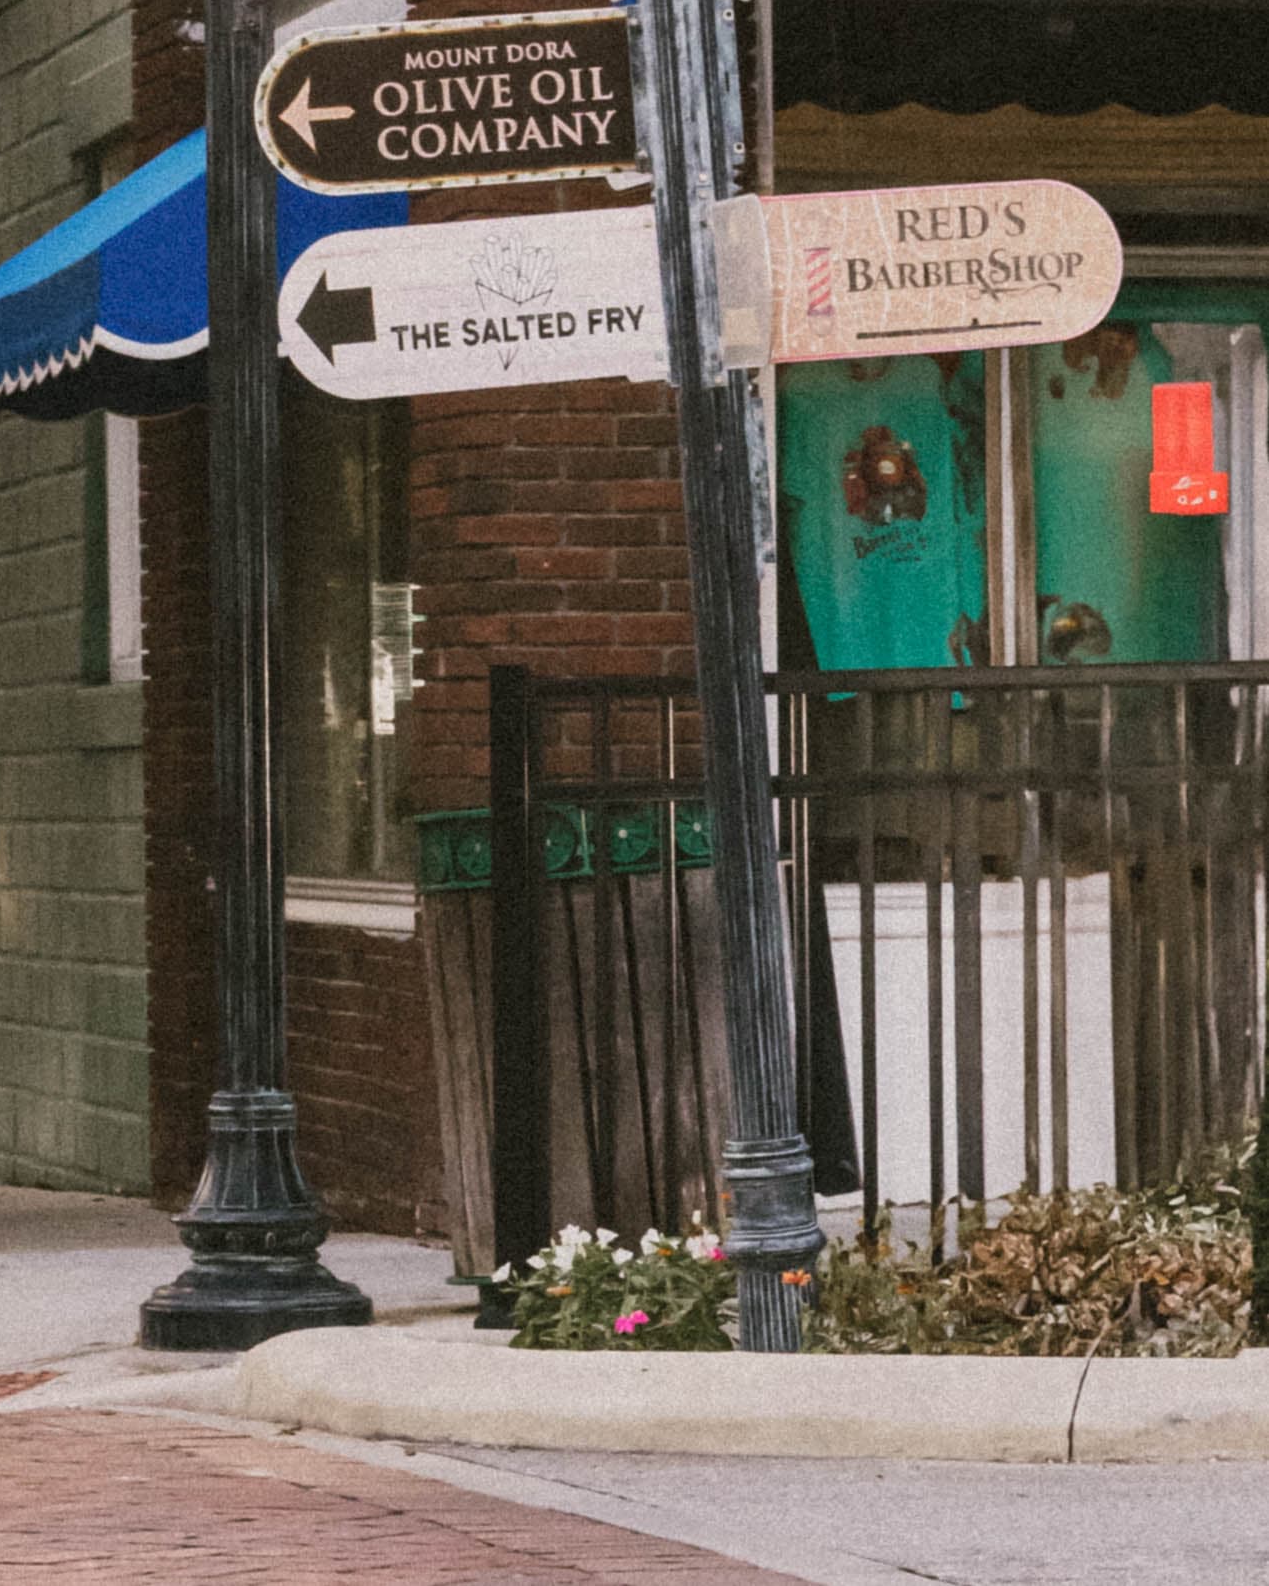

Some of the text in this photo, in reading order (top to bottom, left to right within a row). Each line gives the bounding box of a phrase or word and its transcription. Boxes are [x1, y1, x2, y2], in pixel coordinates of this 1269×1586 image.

[404, 39, 577, 71] MOUNT DORA
[373, 65, 614, 117] OLIVE OIL
[376, 108, 618, 162] COMPANY
[896, 200, 1027, 244] RED'S
[390, 304, 646, 352] THE SALTED FRY
